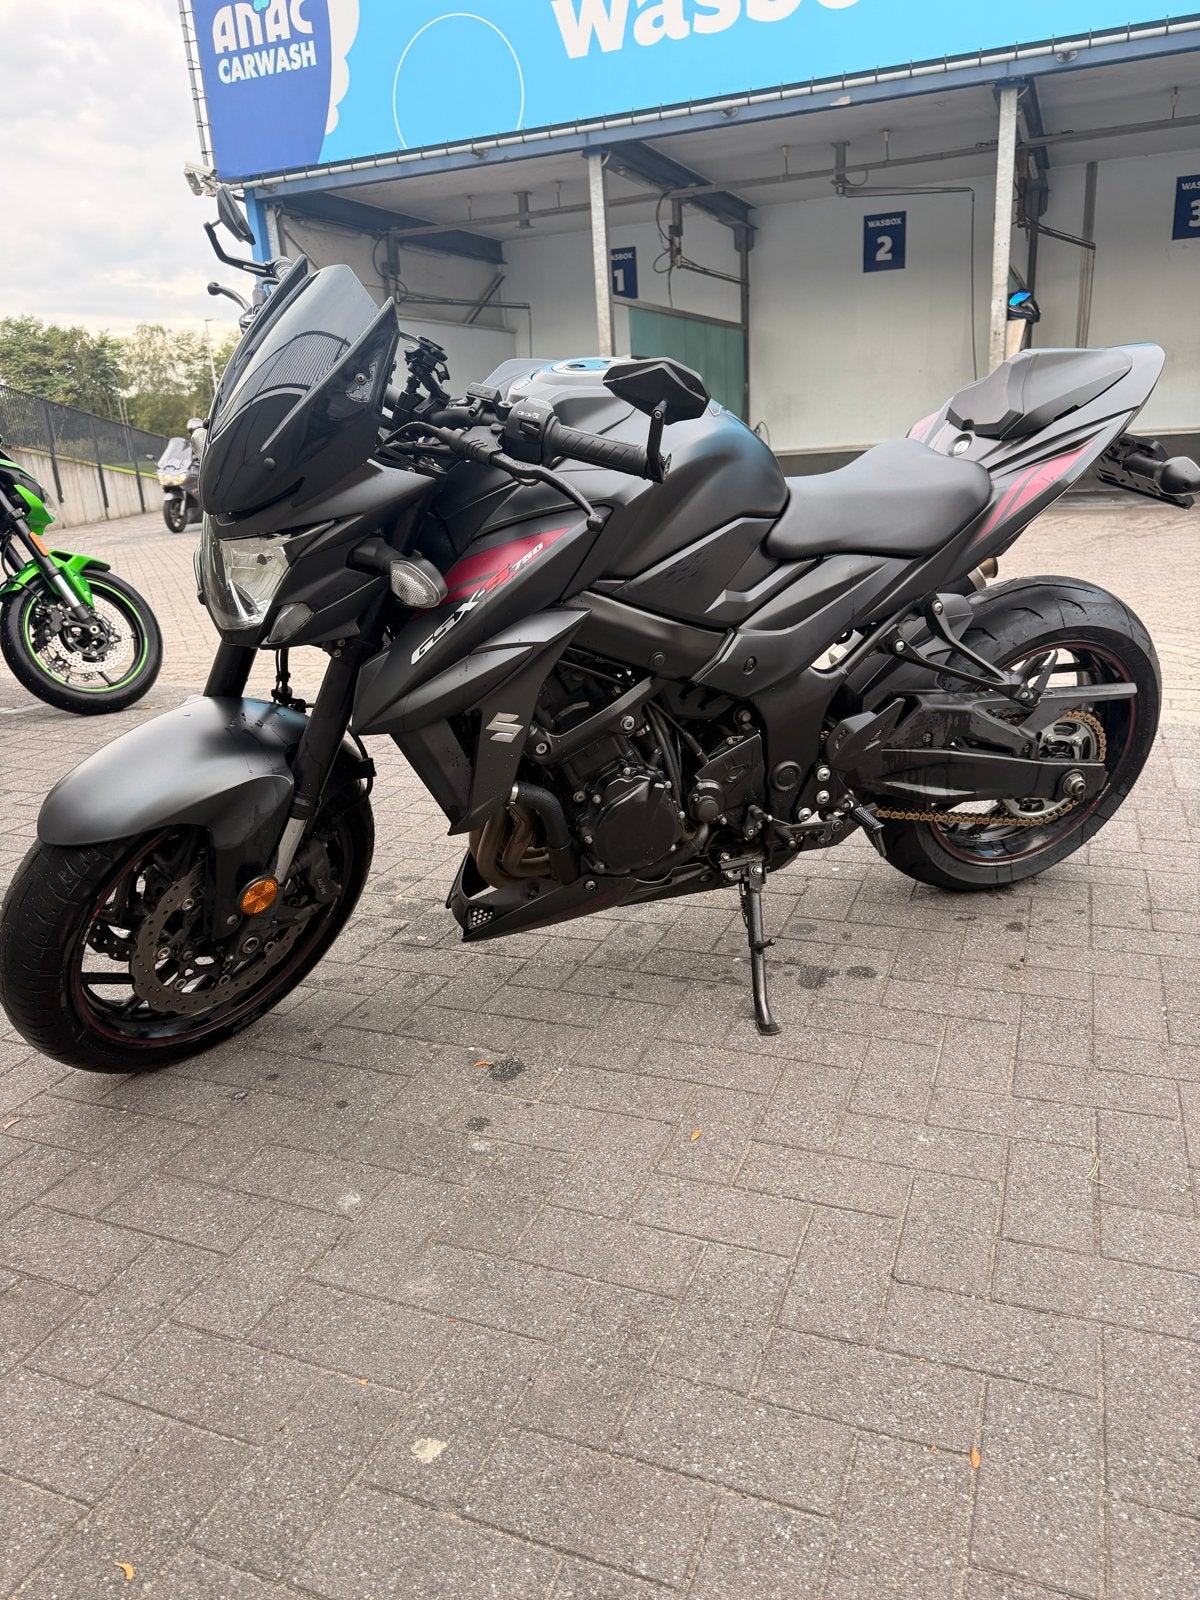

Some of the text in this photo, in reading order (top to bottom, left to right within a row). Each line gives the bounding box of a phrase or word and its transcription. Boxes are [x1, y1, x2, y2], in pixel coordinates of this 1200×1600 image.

[218, 40, 317, 84] CARWASH
[867, 217, 902, 228] WASBOX
[875, 235, 893, 261] 2
[613, 268, 625, 291] 1
[511, 542, 544, 571] 750
